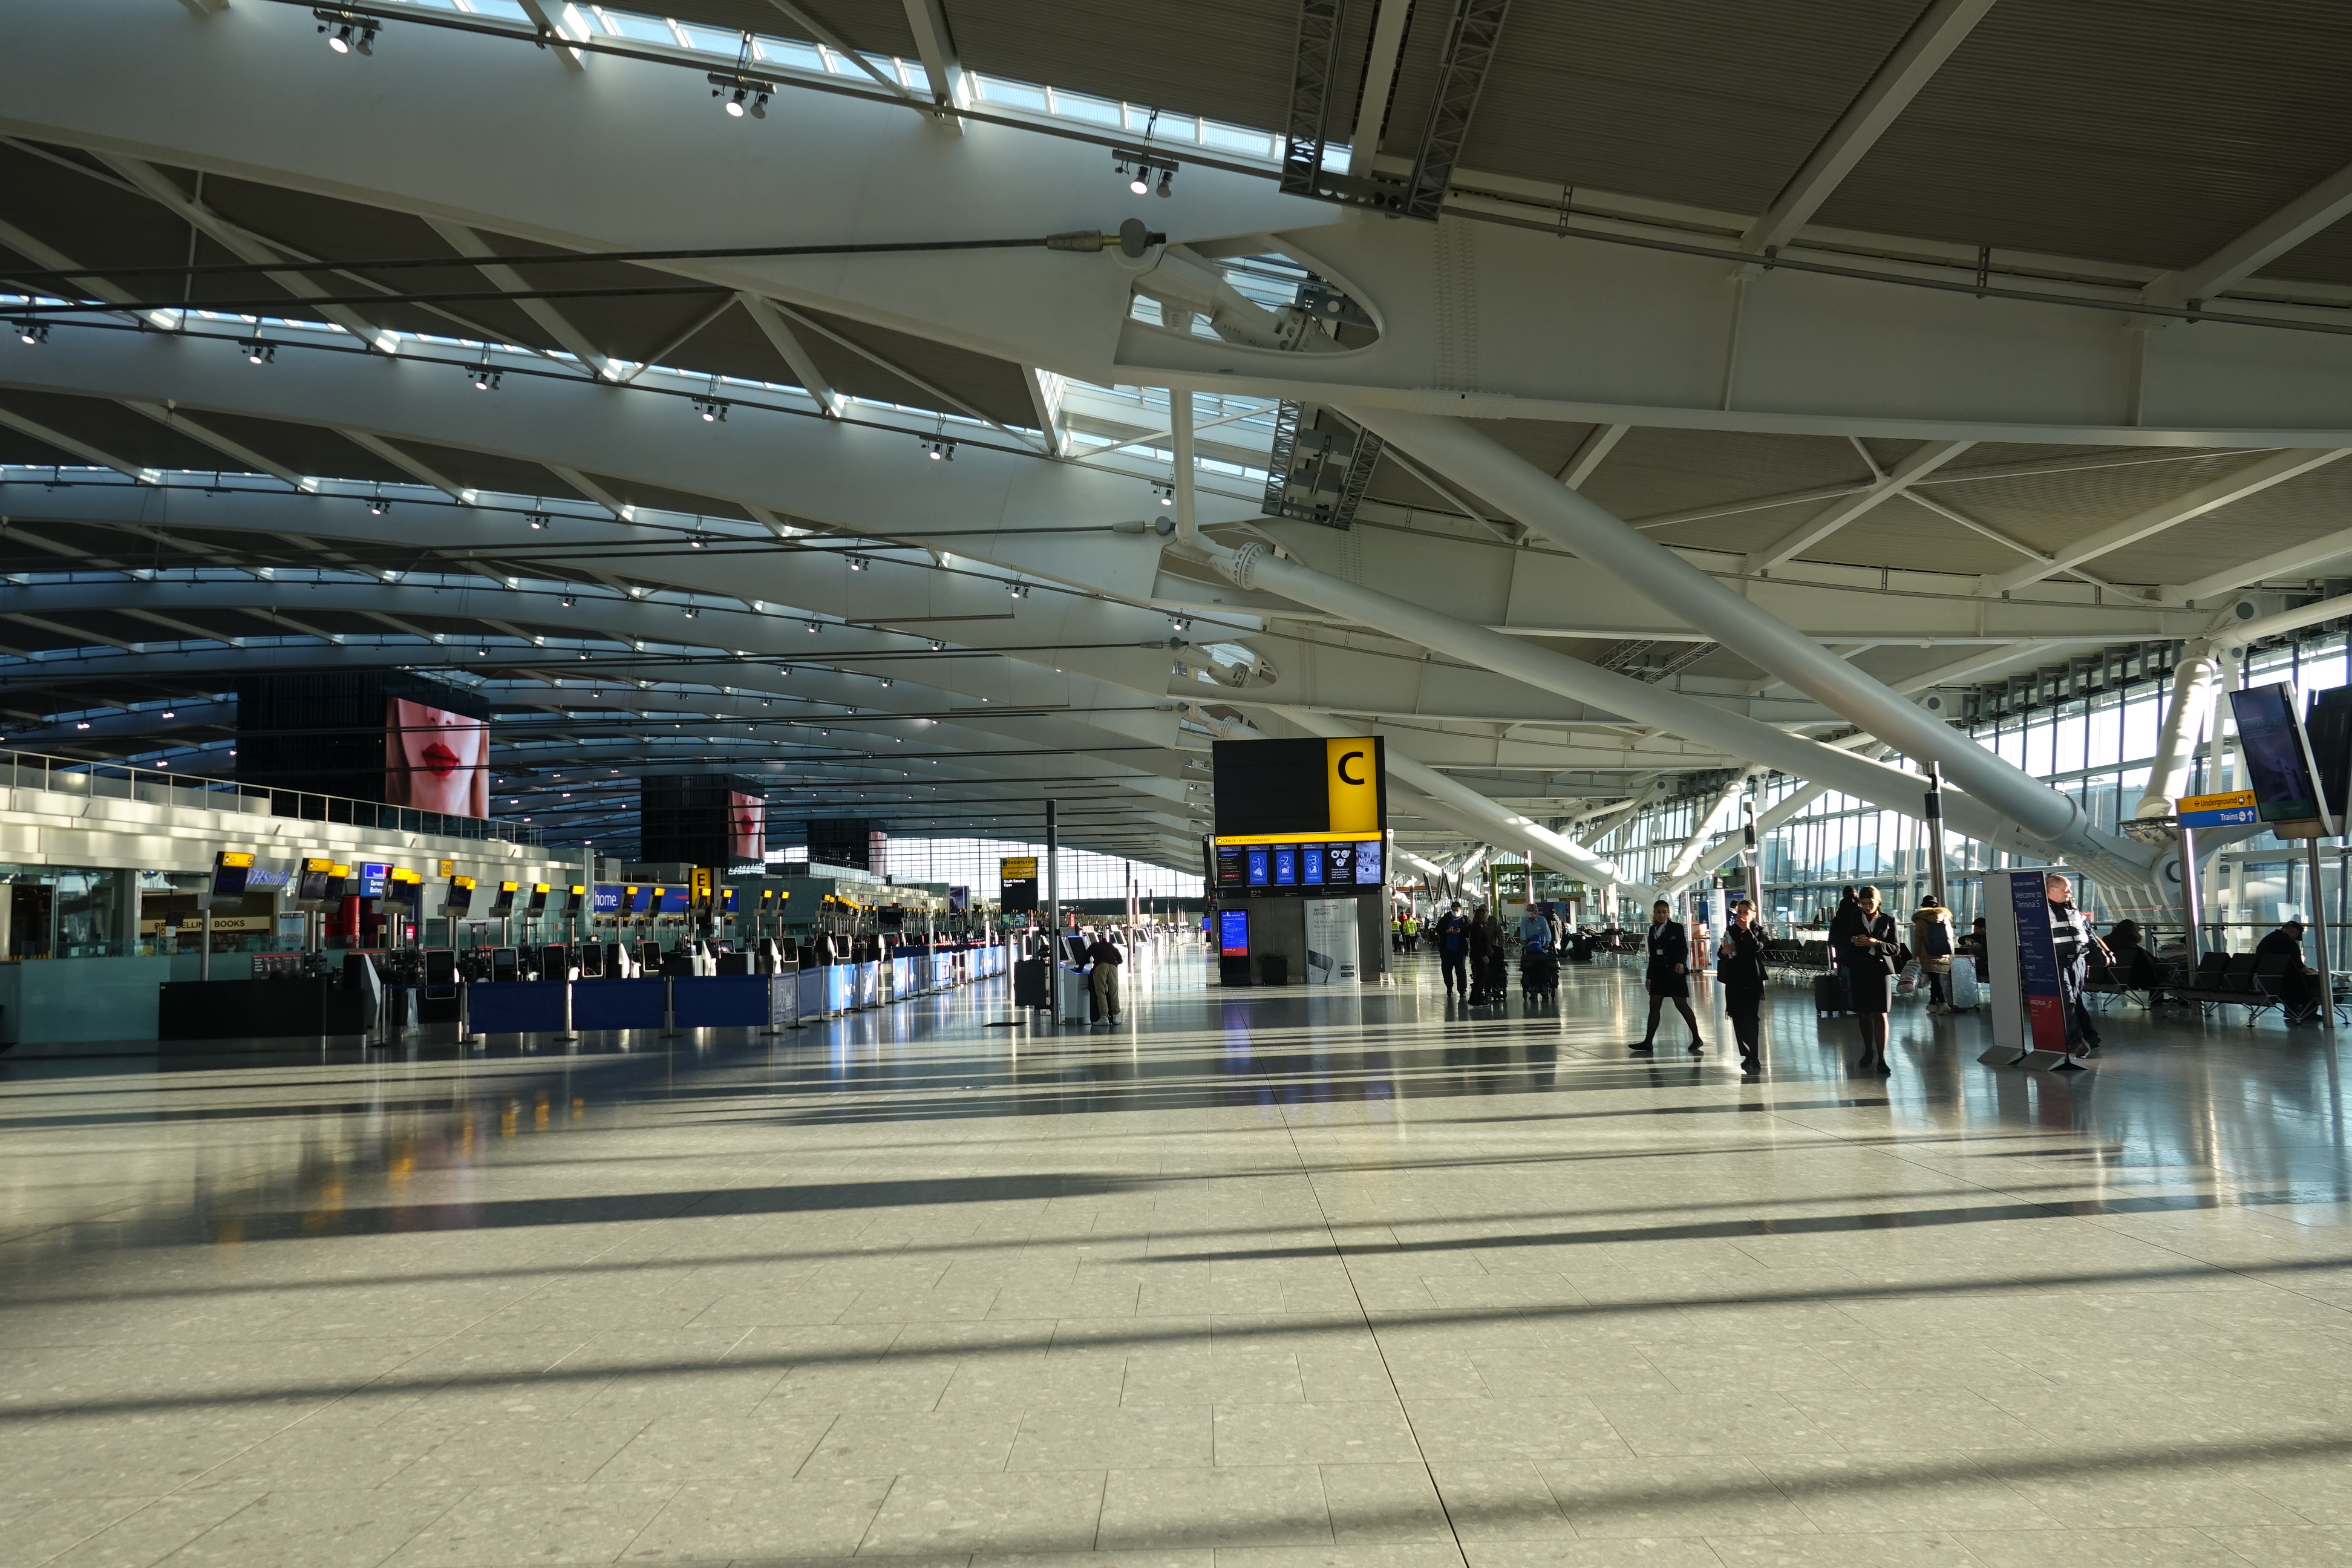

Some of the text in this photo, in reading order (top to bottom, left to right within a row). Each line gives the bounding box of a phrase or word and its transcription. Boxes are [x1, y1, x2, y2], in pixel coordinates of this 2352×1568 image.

[1338, 751, 1365, 785] C
[2201, 796, 2237, 806] Underground
[2220, 812, 2238, 821] Trains
[1256, 858, 1260, 866] 1
[1283, 856, 1289, 865] 2
[1311, 855, 1317, 864] 3
[697, 874, 705, 886] E
[595, 890, 618, 906] home.
